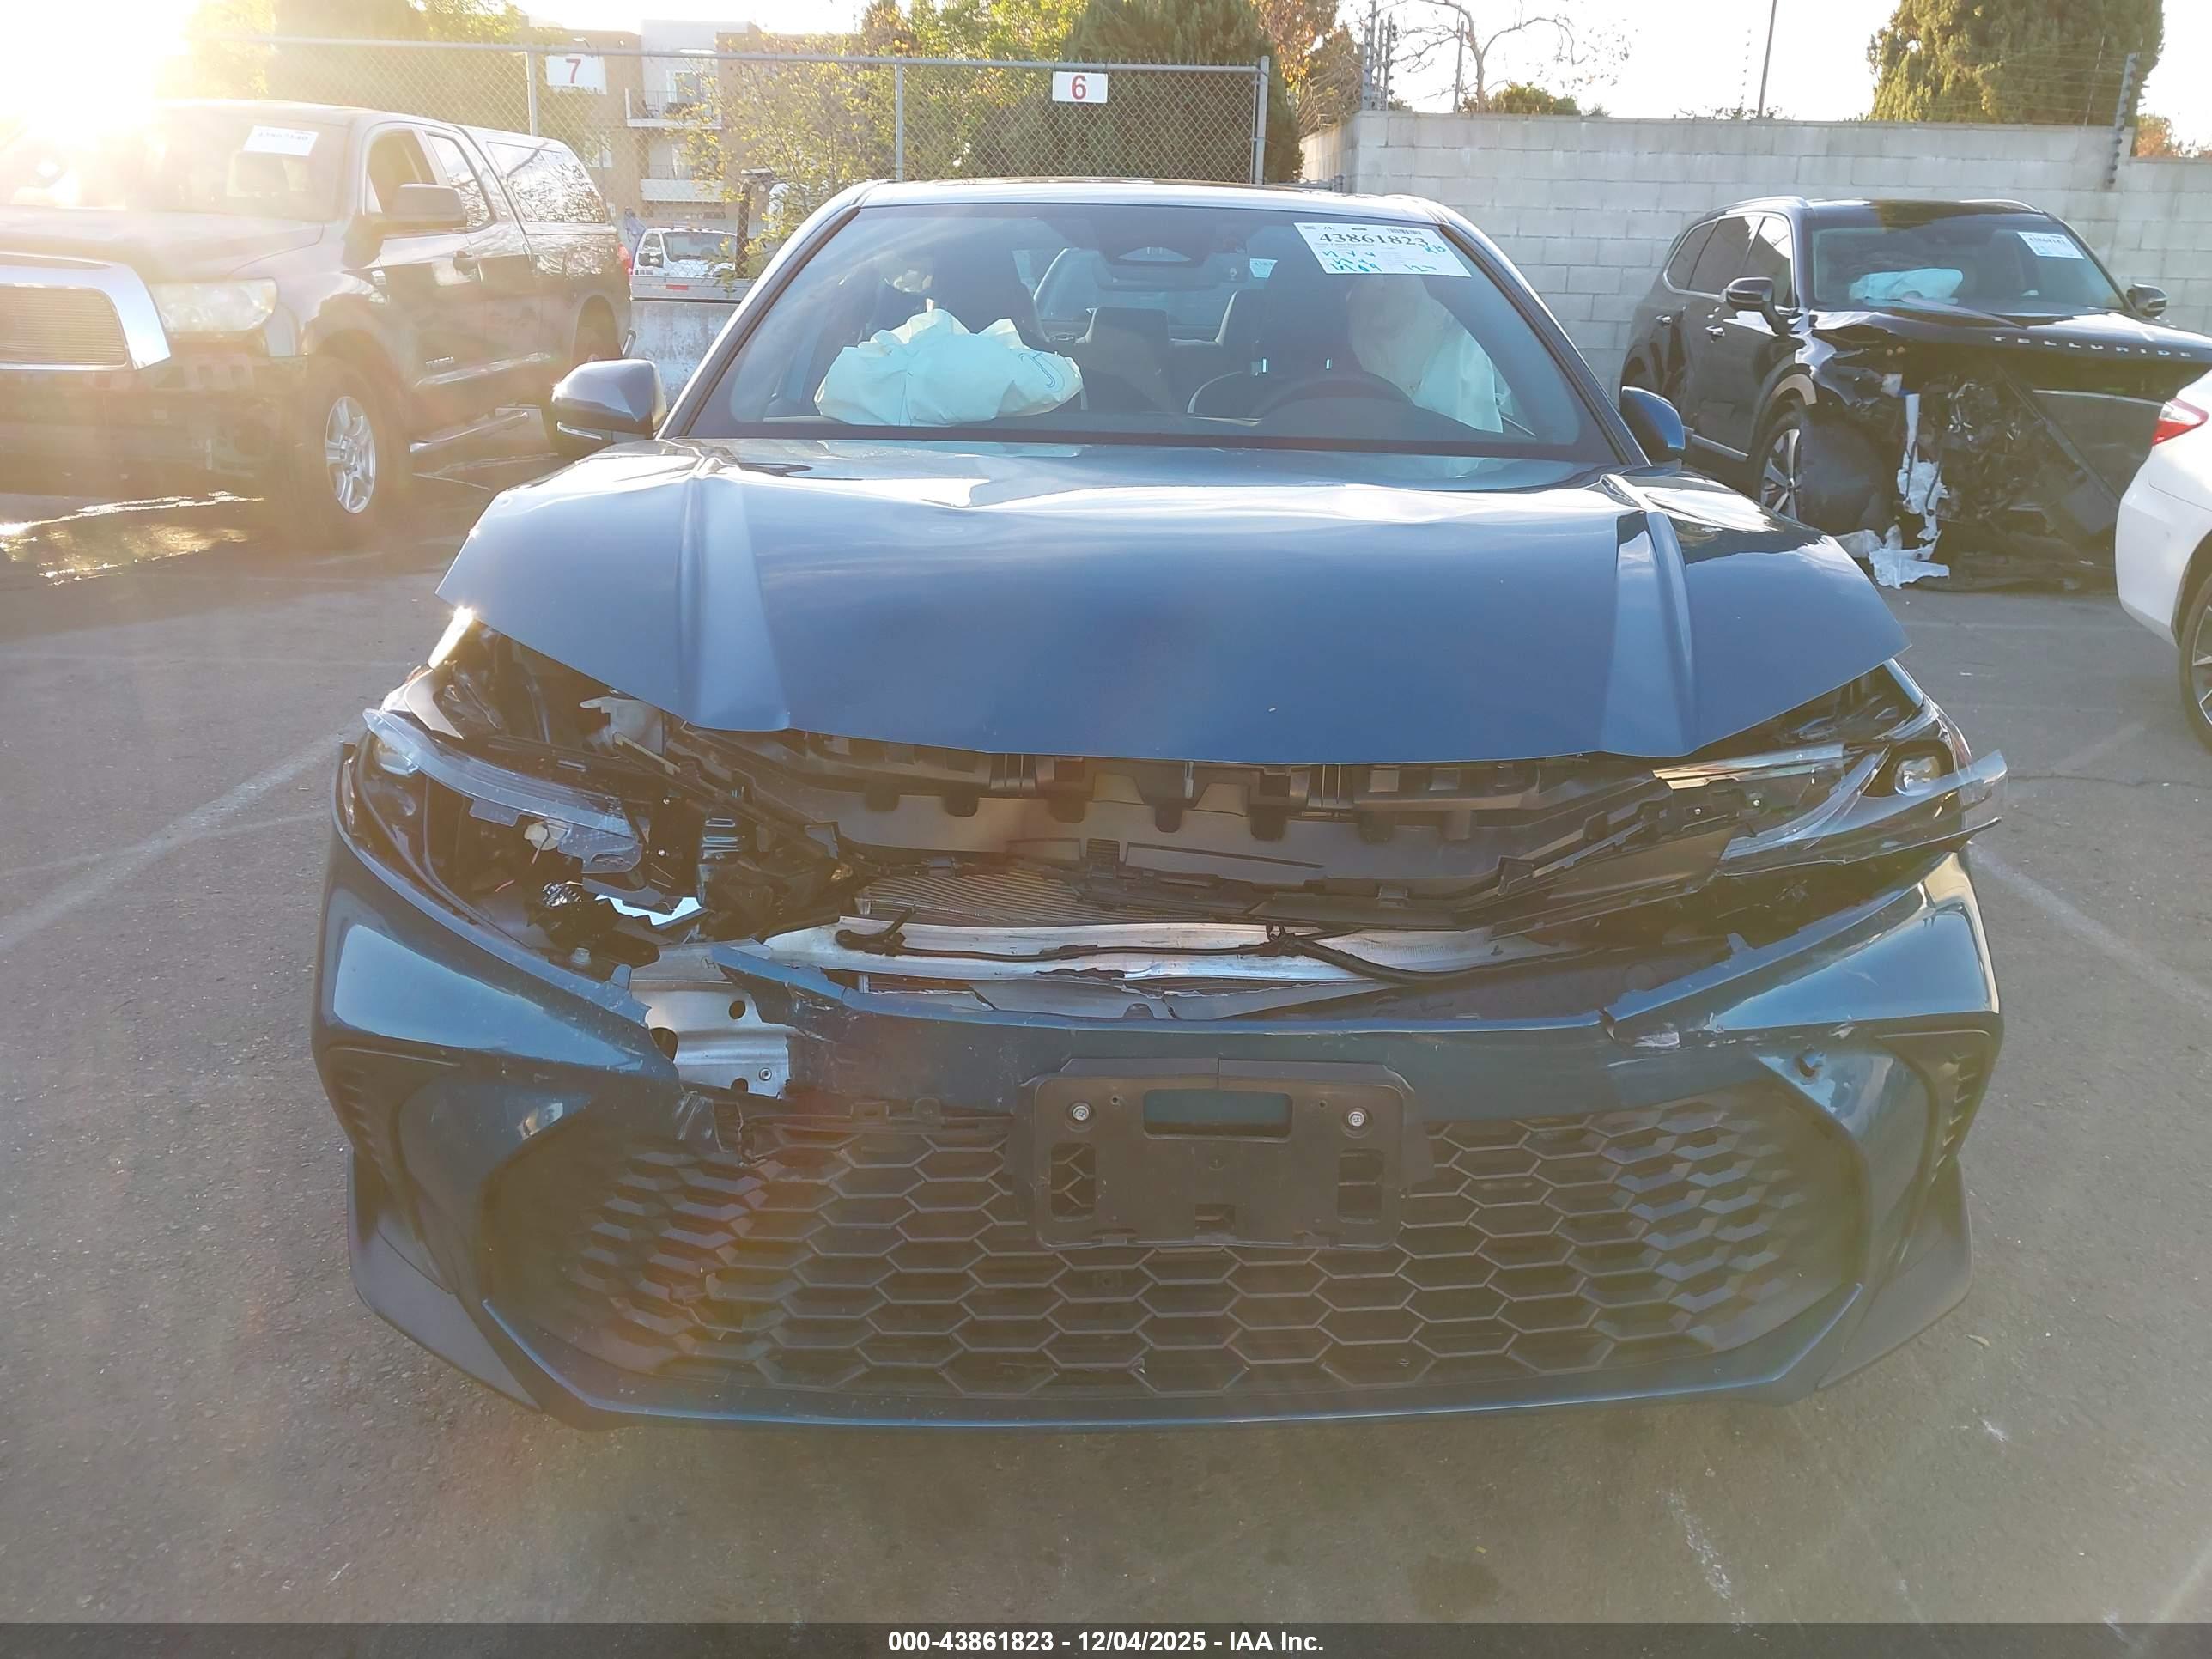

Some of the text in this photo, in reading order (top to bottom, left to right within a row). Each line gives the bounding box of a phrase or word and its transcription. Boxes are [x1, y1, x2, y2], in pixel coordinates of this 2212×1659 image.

[565, 58, 581, 84] 7
[1071, 75, 1087, 100] 6
[1319, 233, 1429, 247] 43861823
[1990, 335, 2192, 357] TELLURIDE
